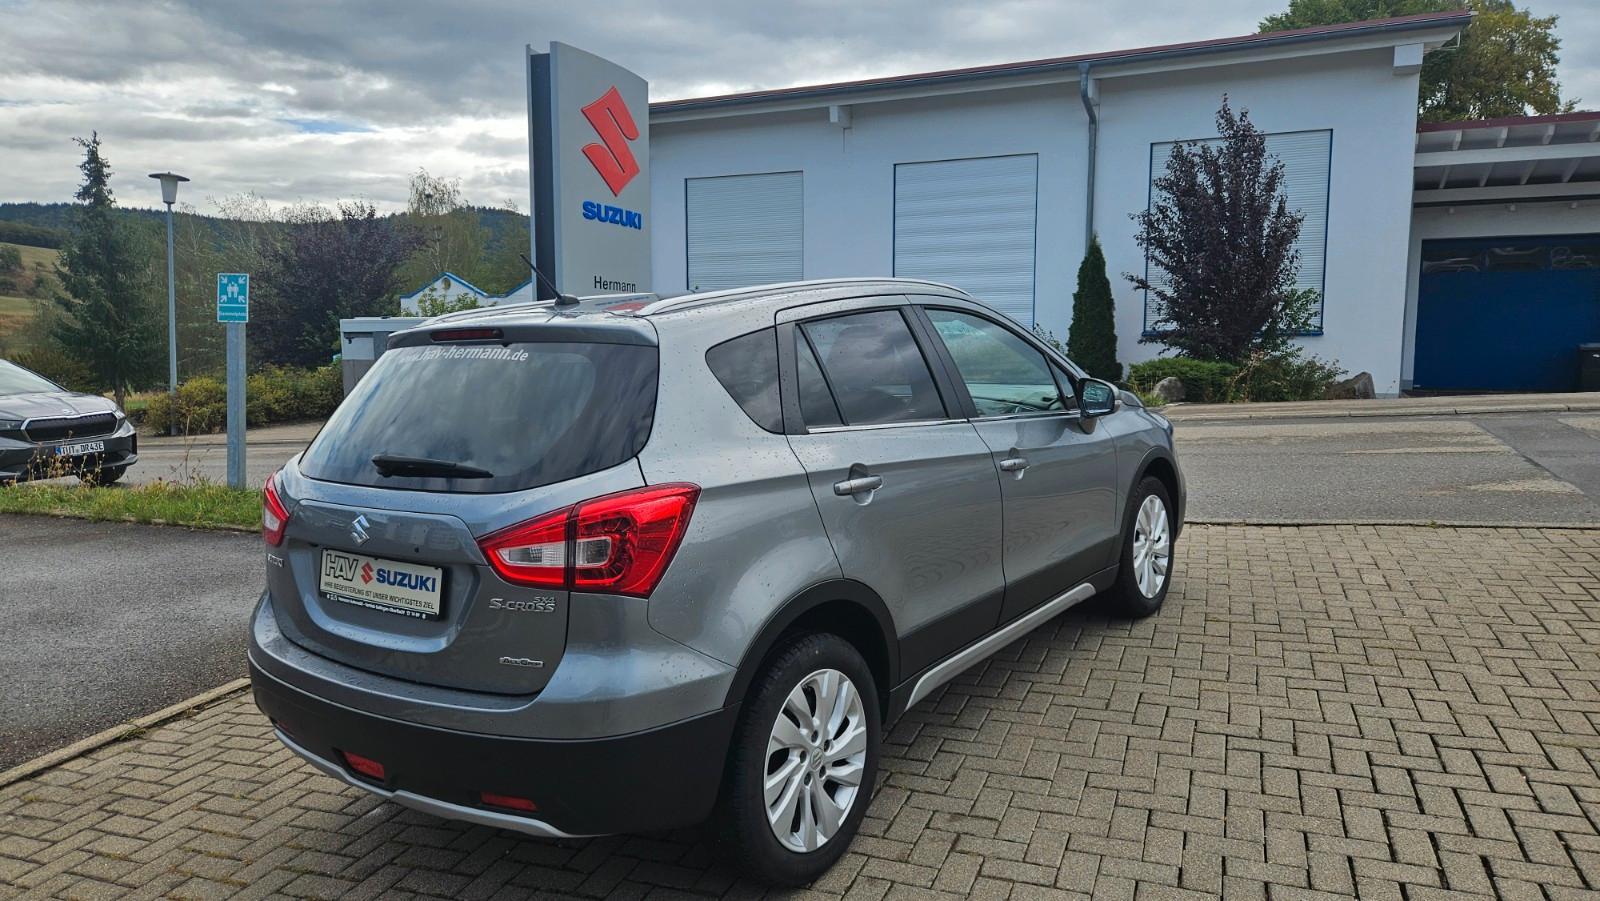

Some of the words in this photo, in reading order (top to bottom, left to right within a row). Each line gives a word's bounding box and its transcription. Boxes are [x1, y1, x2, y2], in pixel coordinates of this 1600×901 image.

[582, 200, 642, 230] SUZUKI
[594, 275, 636, 293] Hermann
[400, 345, 528, 361] w.hav-hermann.de
[325, 553, 359, 582] HAV
[376, 567, 437, 593] SUZUKI
[533, 596, 555, 604] SX4
